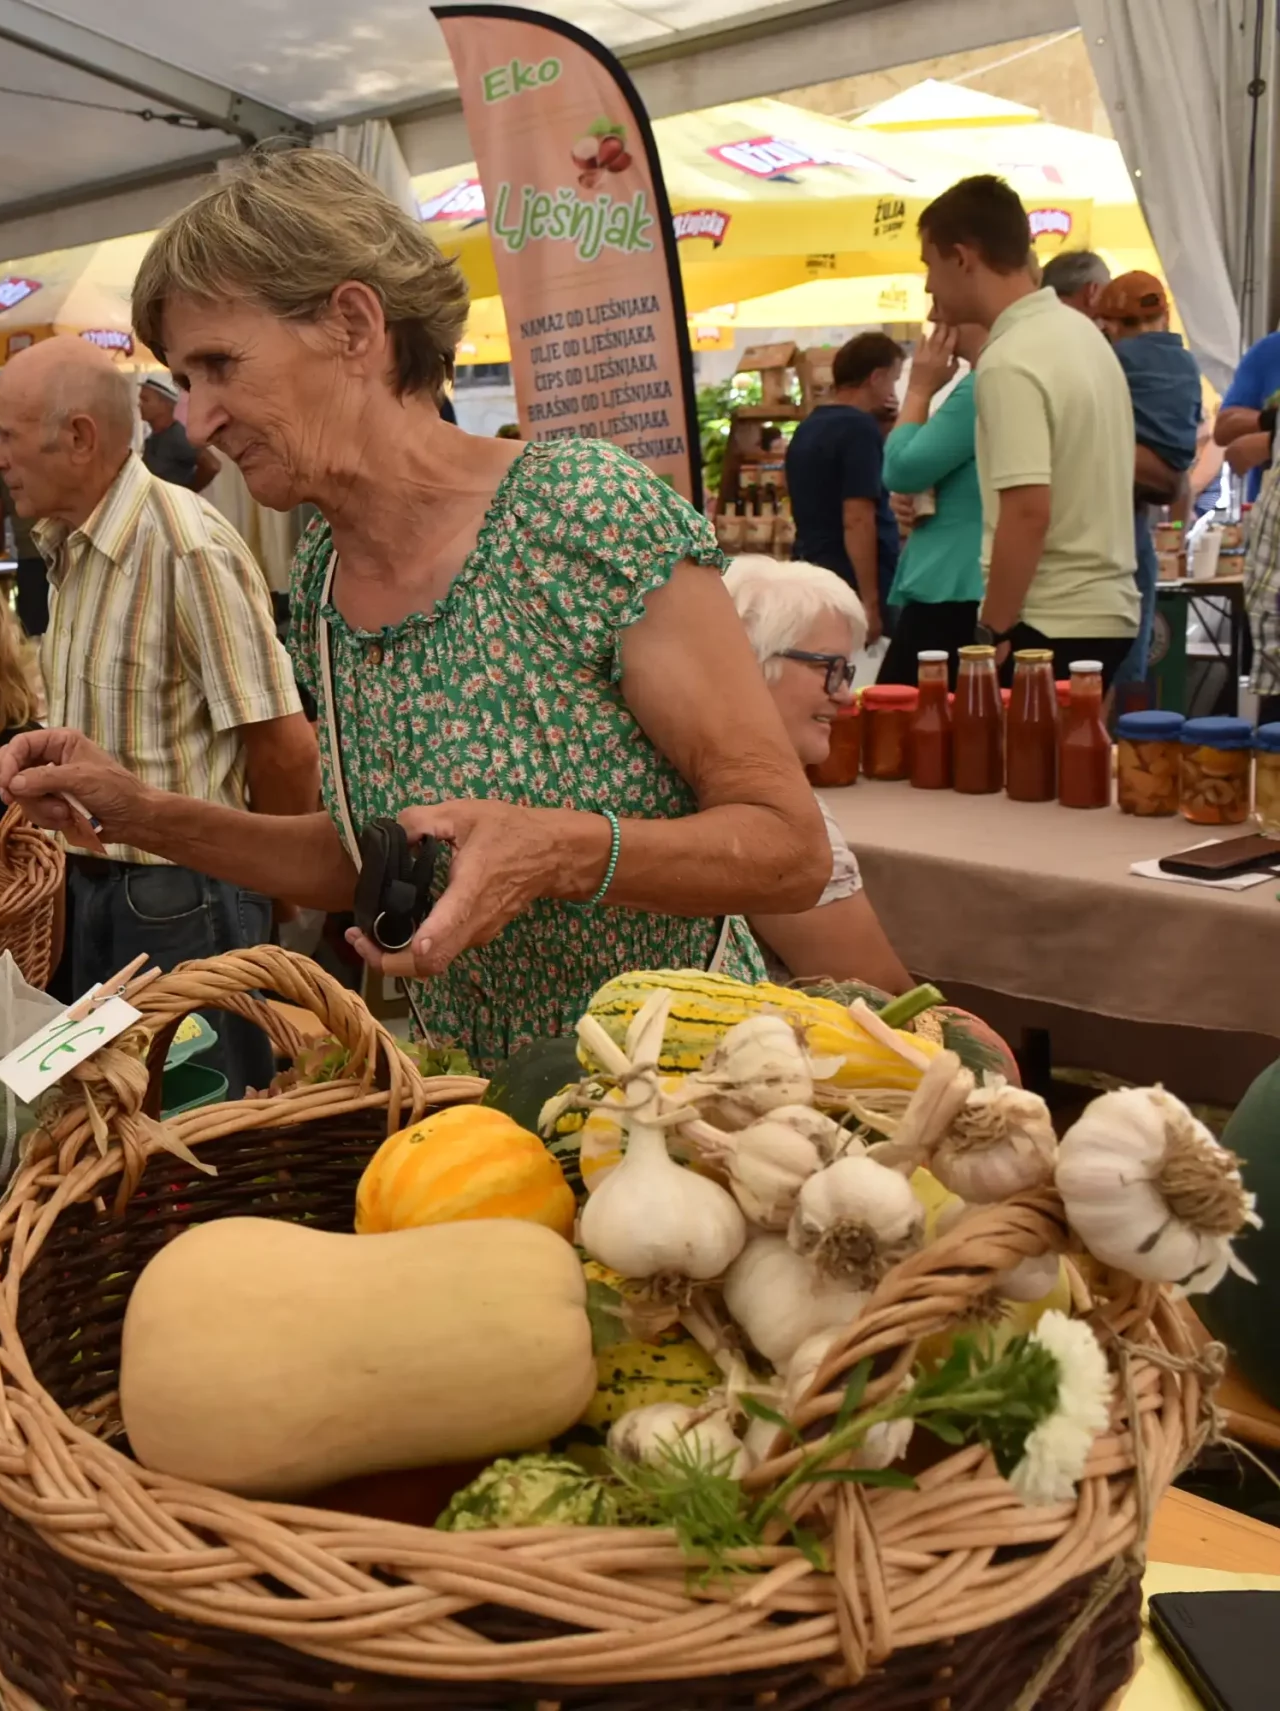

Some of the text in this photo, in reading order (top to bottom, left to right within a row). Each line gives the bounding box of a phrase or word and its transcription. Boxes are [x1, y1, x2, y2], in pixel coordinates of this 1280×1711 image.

[482, 57, 561, 104] Eko
[493, 184, 655, 261] Lješnjak
[520, 295, 660, 339] NAMAZ OD LJEŠNJAKA
[530, 324, 656, 365] ULJE OD LJEŠNJAKA
[534, 353, 658, 392] ČIPS OD LJEŠNJAKA
[527, 380, 673, 422] BRAŠNO OD LJEŠNJAKA
[600, 409, 670, 436] LJEŠNJAKA
